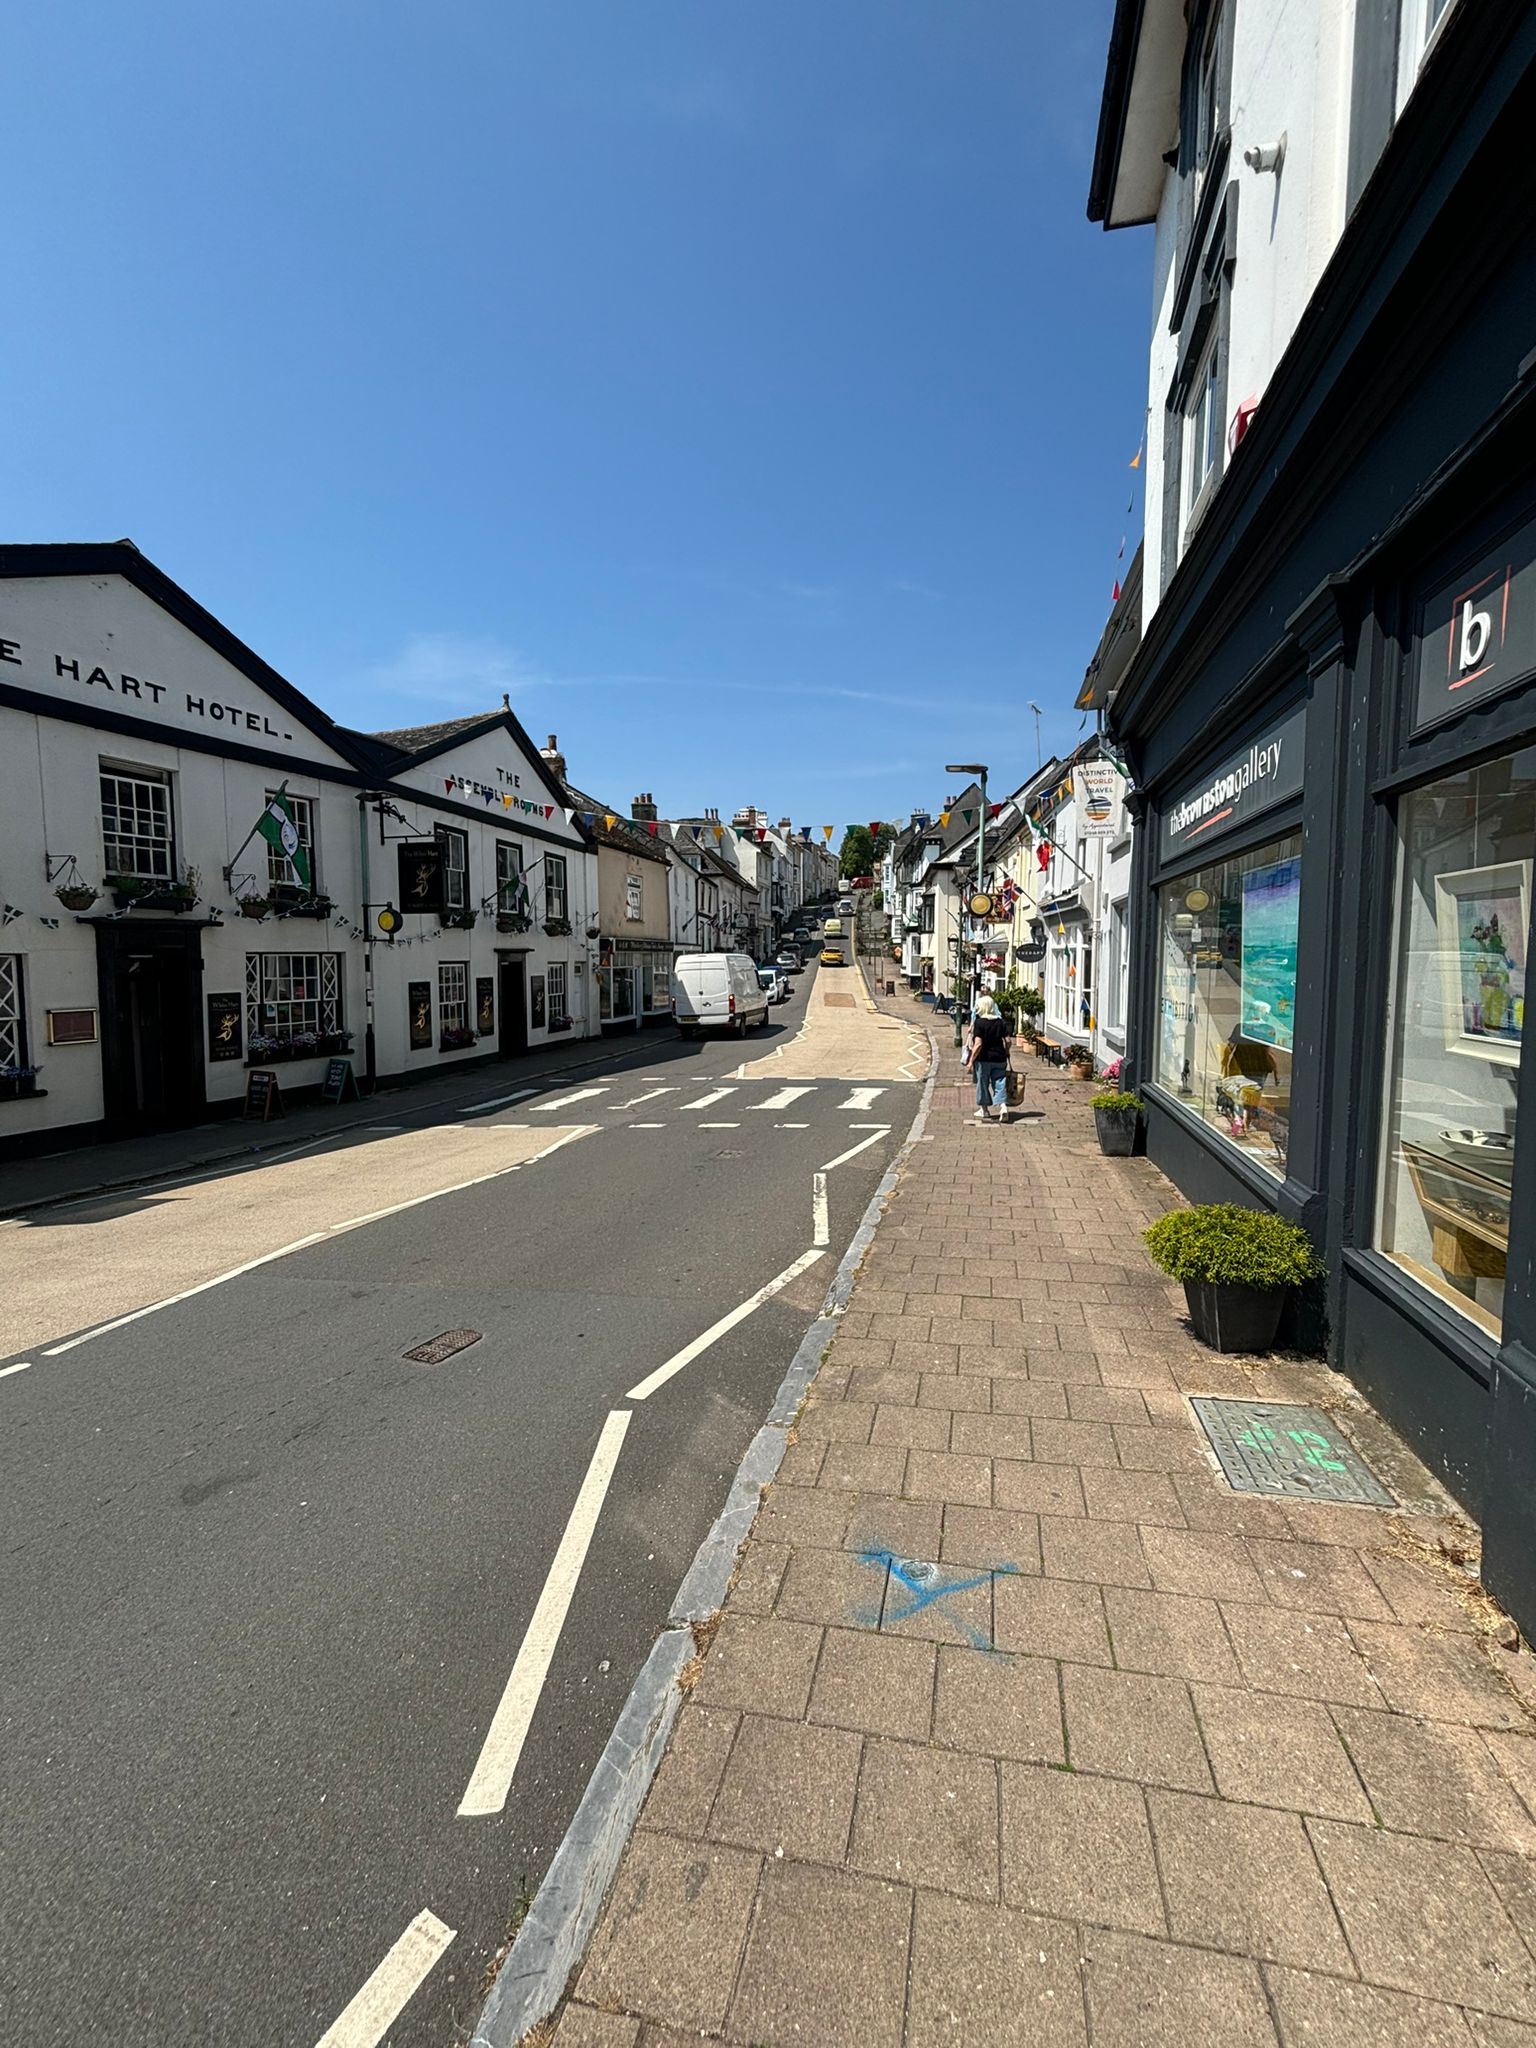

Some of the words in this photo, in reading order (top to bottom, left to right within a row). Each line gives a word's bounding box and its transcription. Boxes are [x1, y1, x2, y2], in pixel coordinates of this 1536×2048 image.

[1459, 599, 1491, 671] b
[54, 654, 167, 704] HART
[496, 767, 520, 788] THE
[1078, 769, 1118, 777] DISTINCTIV
[1087, 777, 1114, 785] WORLD
[513, 795, 544, 816] ROMS
